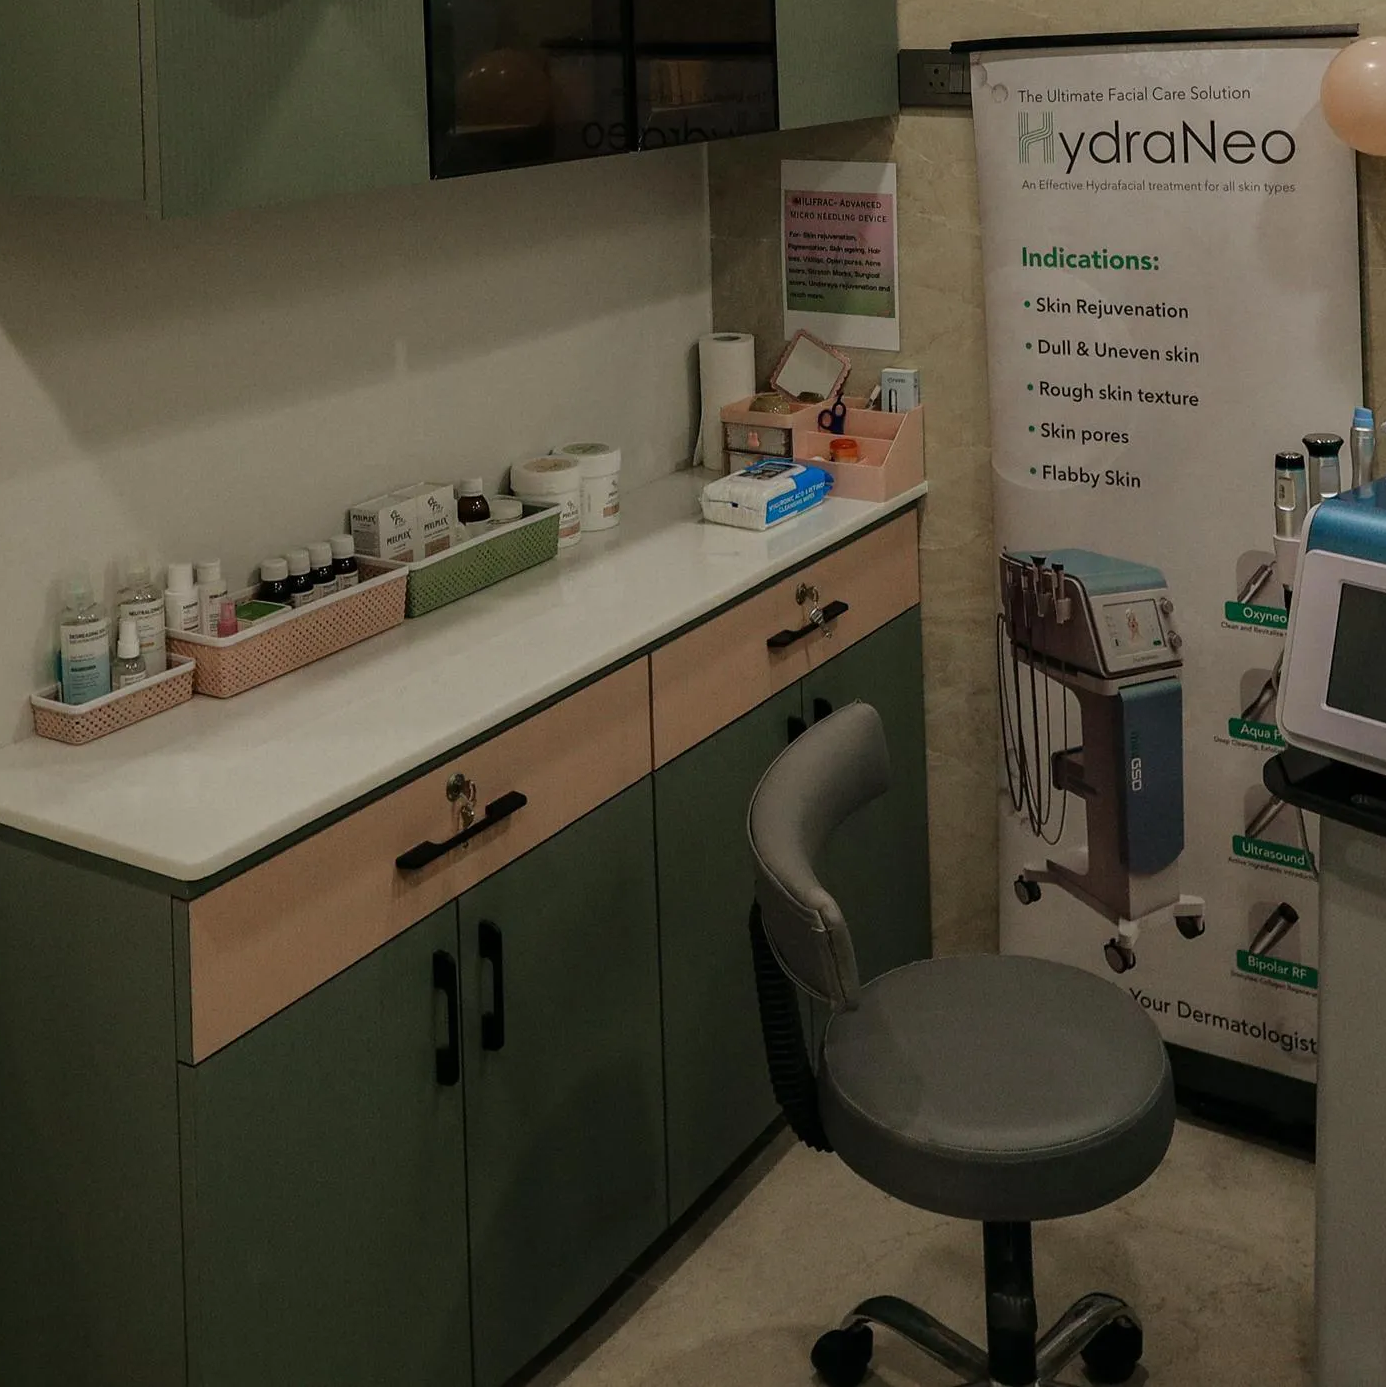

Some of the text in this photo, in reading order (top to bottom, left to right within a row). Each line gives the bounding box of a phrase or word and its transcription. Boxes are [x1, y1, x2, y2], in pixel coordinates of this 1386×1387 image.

[1017, 85, 1251, 103] The Ultimate Facial Care Solution
[1017, 111, 1296, 174] HydraNeo
[1021, 179, 1296, 194] An Effective Hydrafacial treatment for all skin types
[790, 210, 887, 222] MICRO NEEDLING DEVICE
[840, 200, 882, 208] ADVANCED
[1021, 246, 1159, 271] Indications:
[1036, 296, 1189, 320] Skin Rejuvenation
[1037, 339, 1199, 363] Dull & Uneven skin
[1039, 380, 1199, 407] Rough skin texture
[1041, 422, 1129, 445] Skin pores
[1042, 464, 1141, 488] Flabby Skin
[1243, 606, 1287, 624] Oxyneo
[1240, 723, 1271, 739] Aqua
[1241, 841, 1305, 866] Ultrasound
[1247, 955, 1308, 980] Bipolar RF
[1129, 988, 1171, 1014] Your
